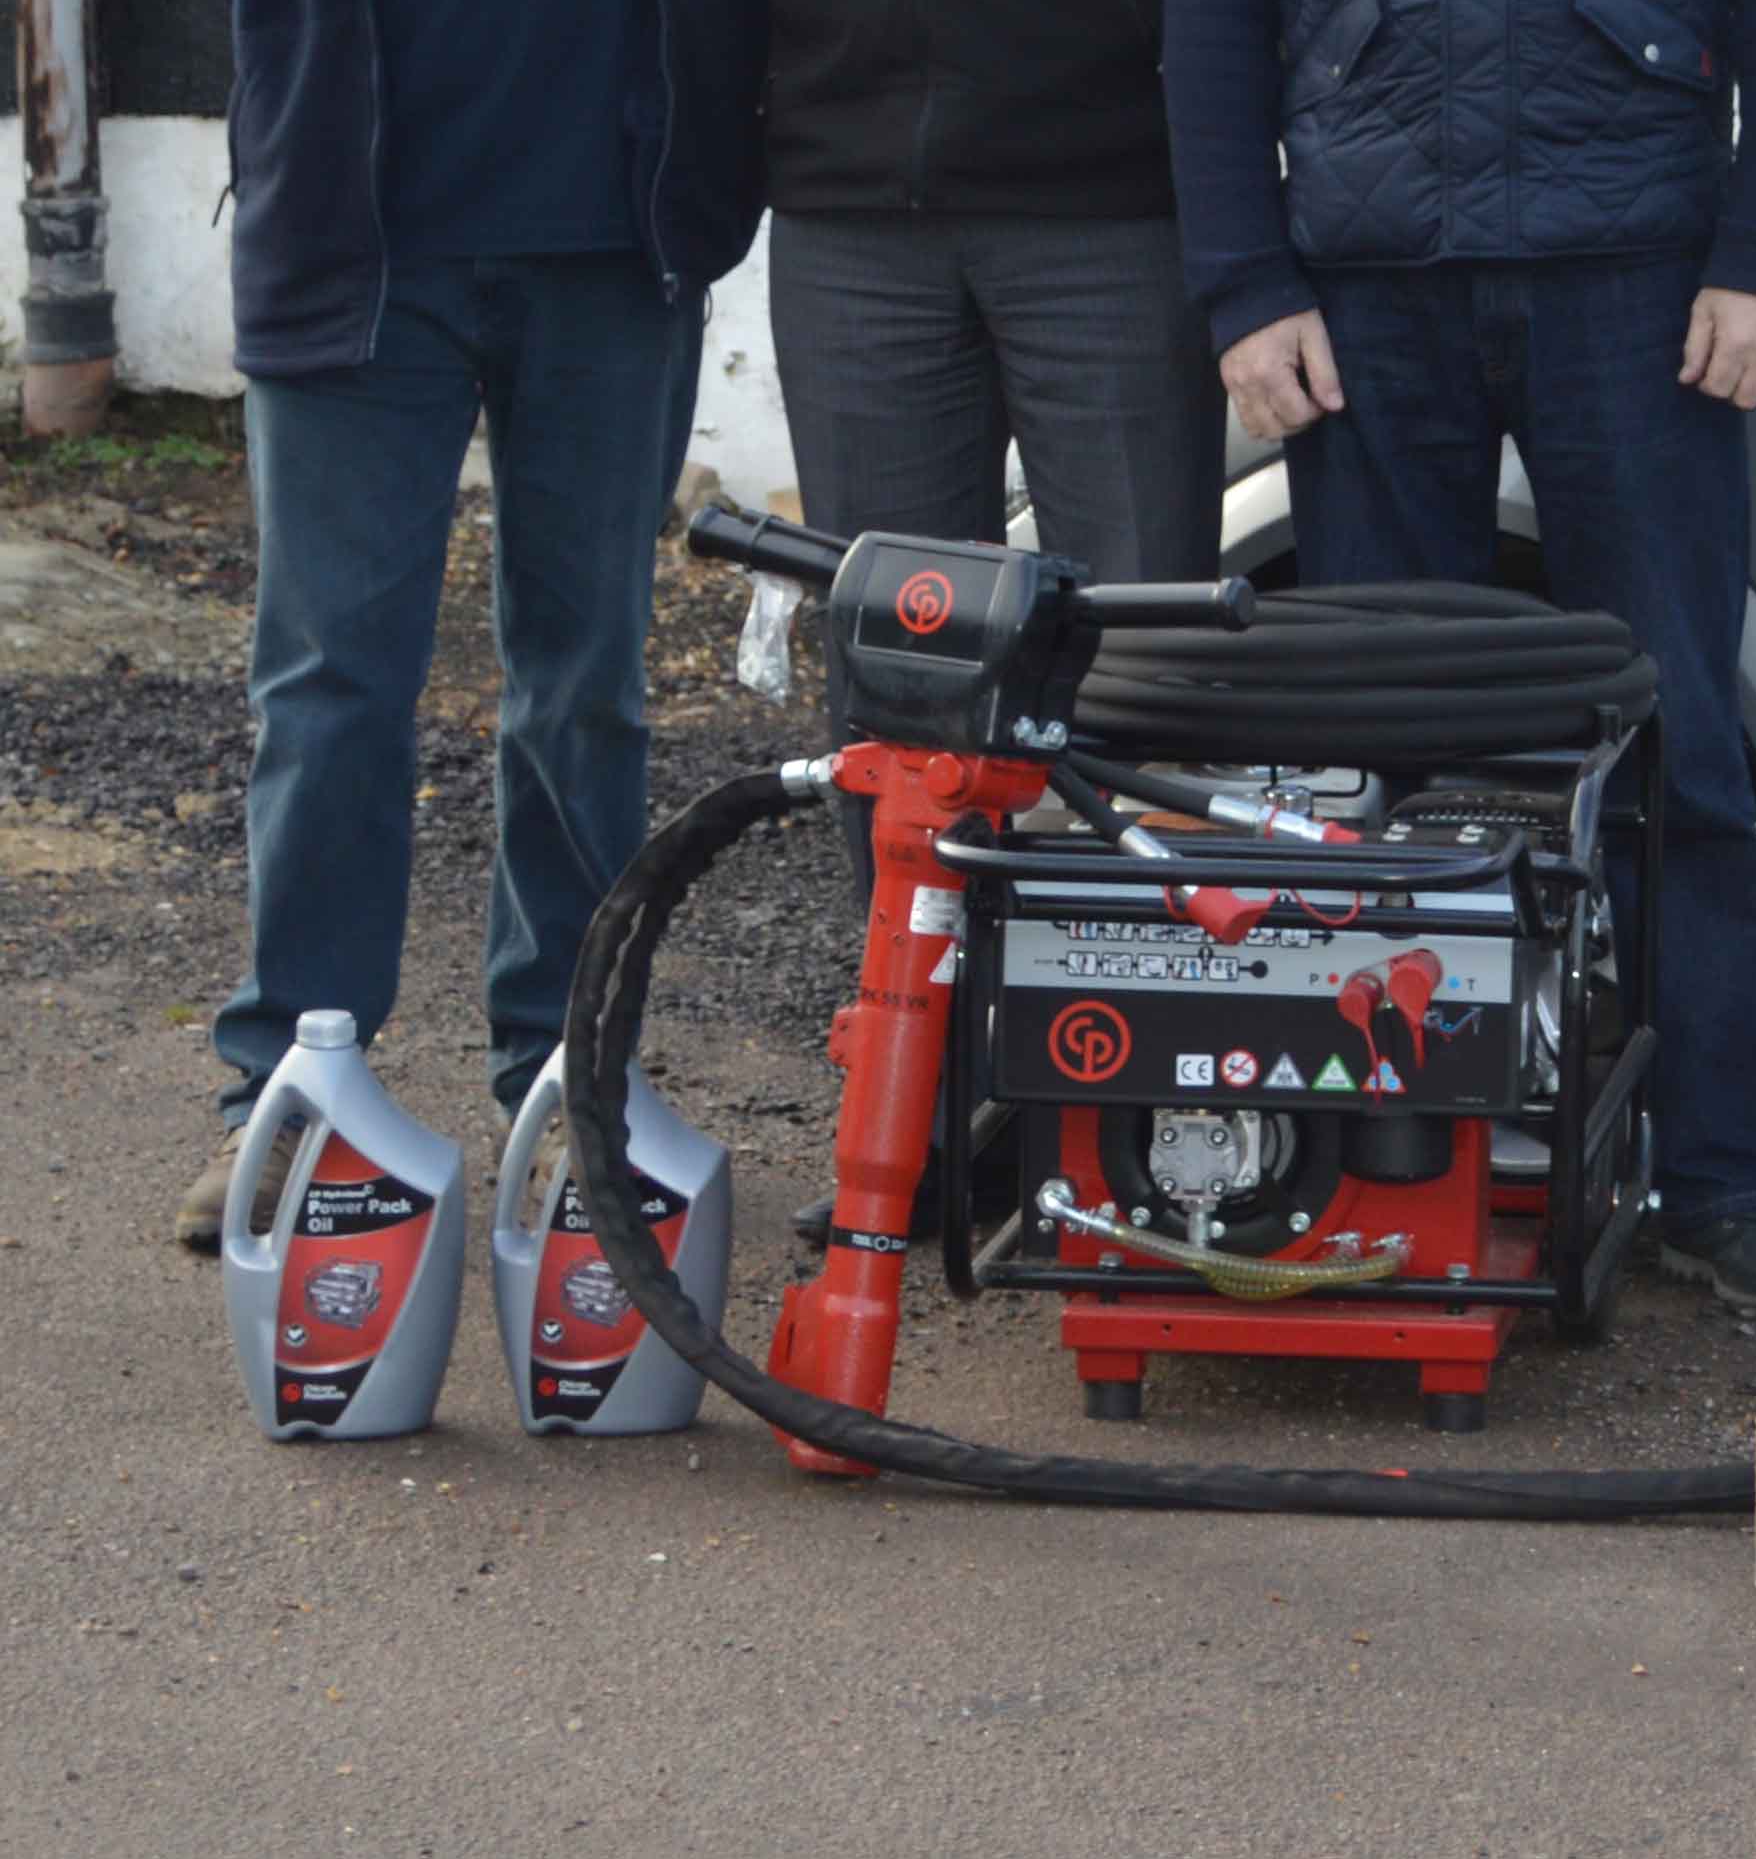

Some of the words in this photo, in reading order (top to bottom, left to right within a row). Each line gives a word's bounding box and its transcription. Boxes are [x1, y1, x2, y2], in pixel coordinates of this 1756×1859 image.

[307, 1200, 363, 1215] Power
[367, 1198, 412, 1214] Pack
[307, 1217, 333, 1233] Oil
